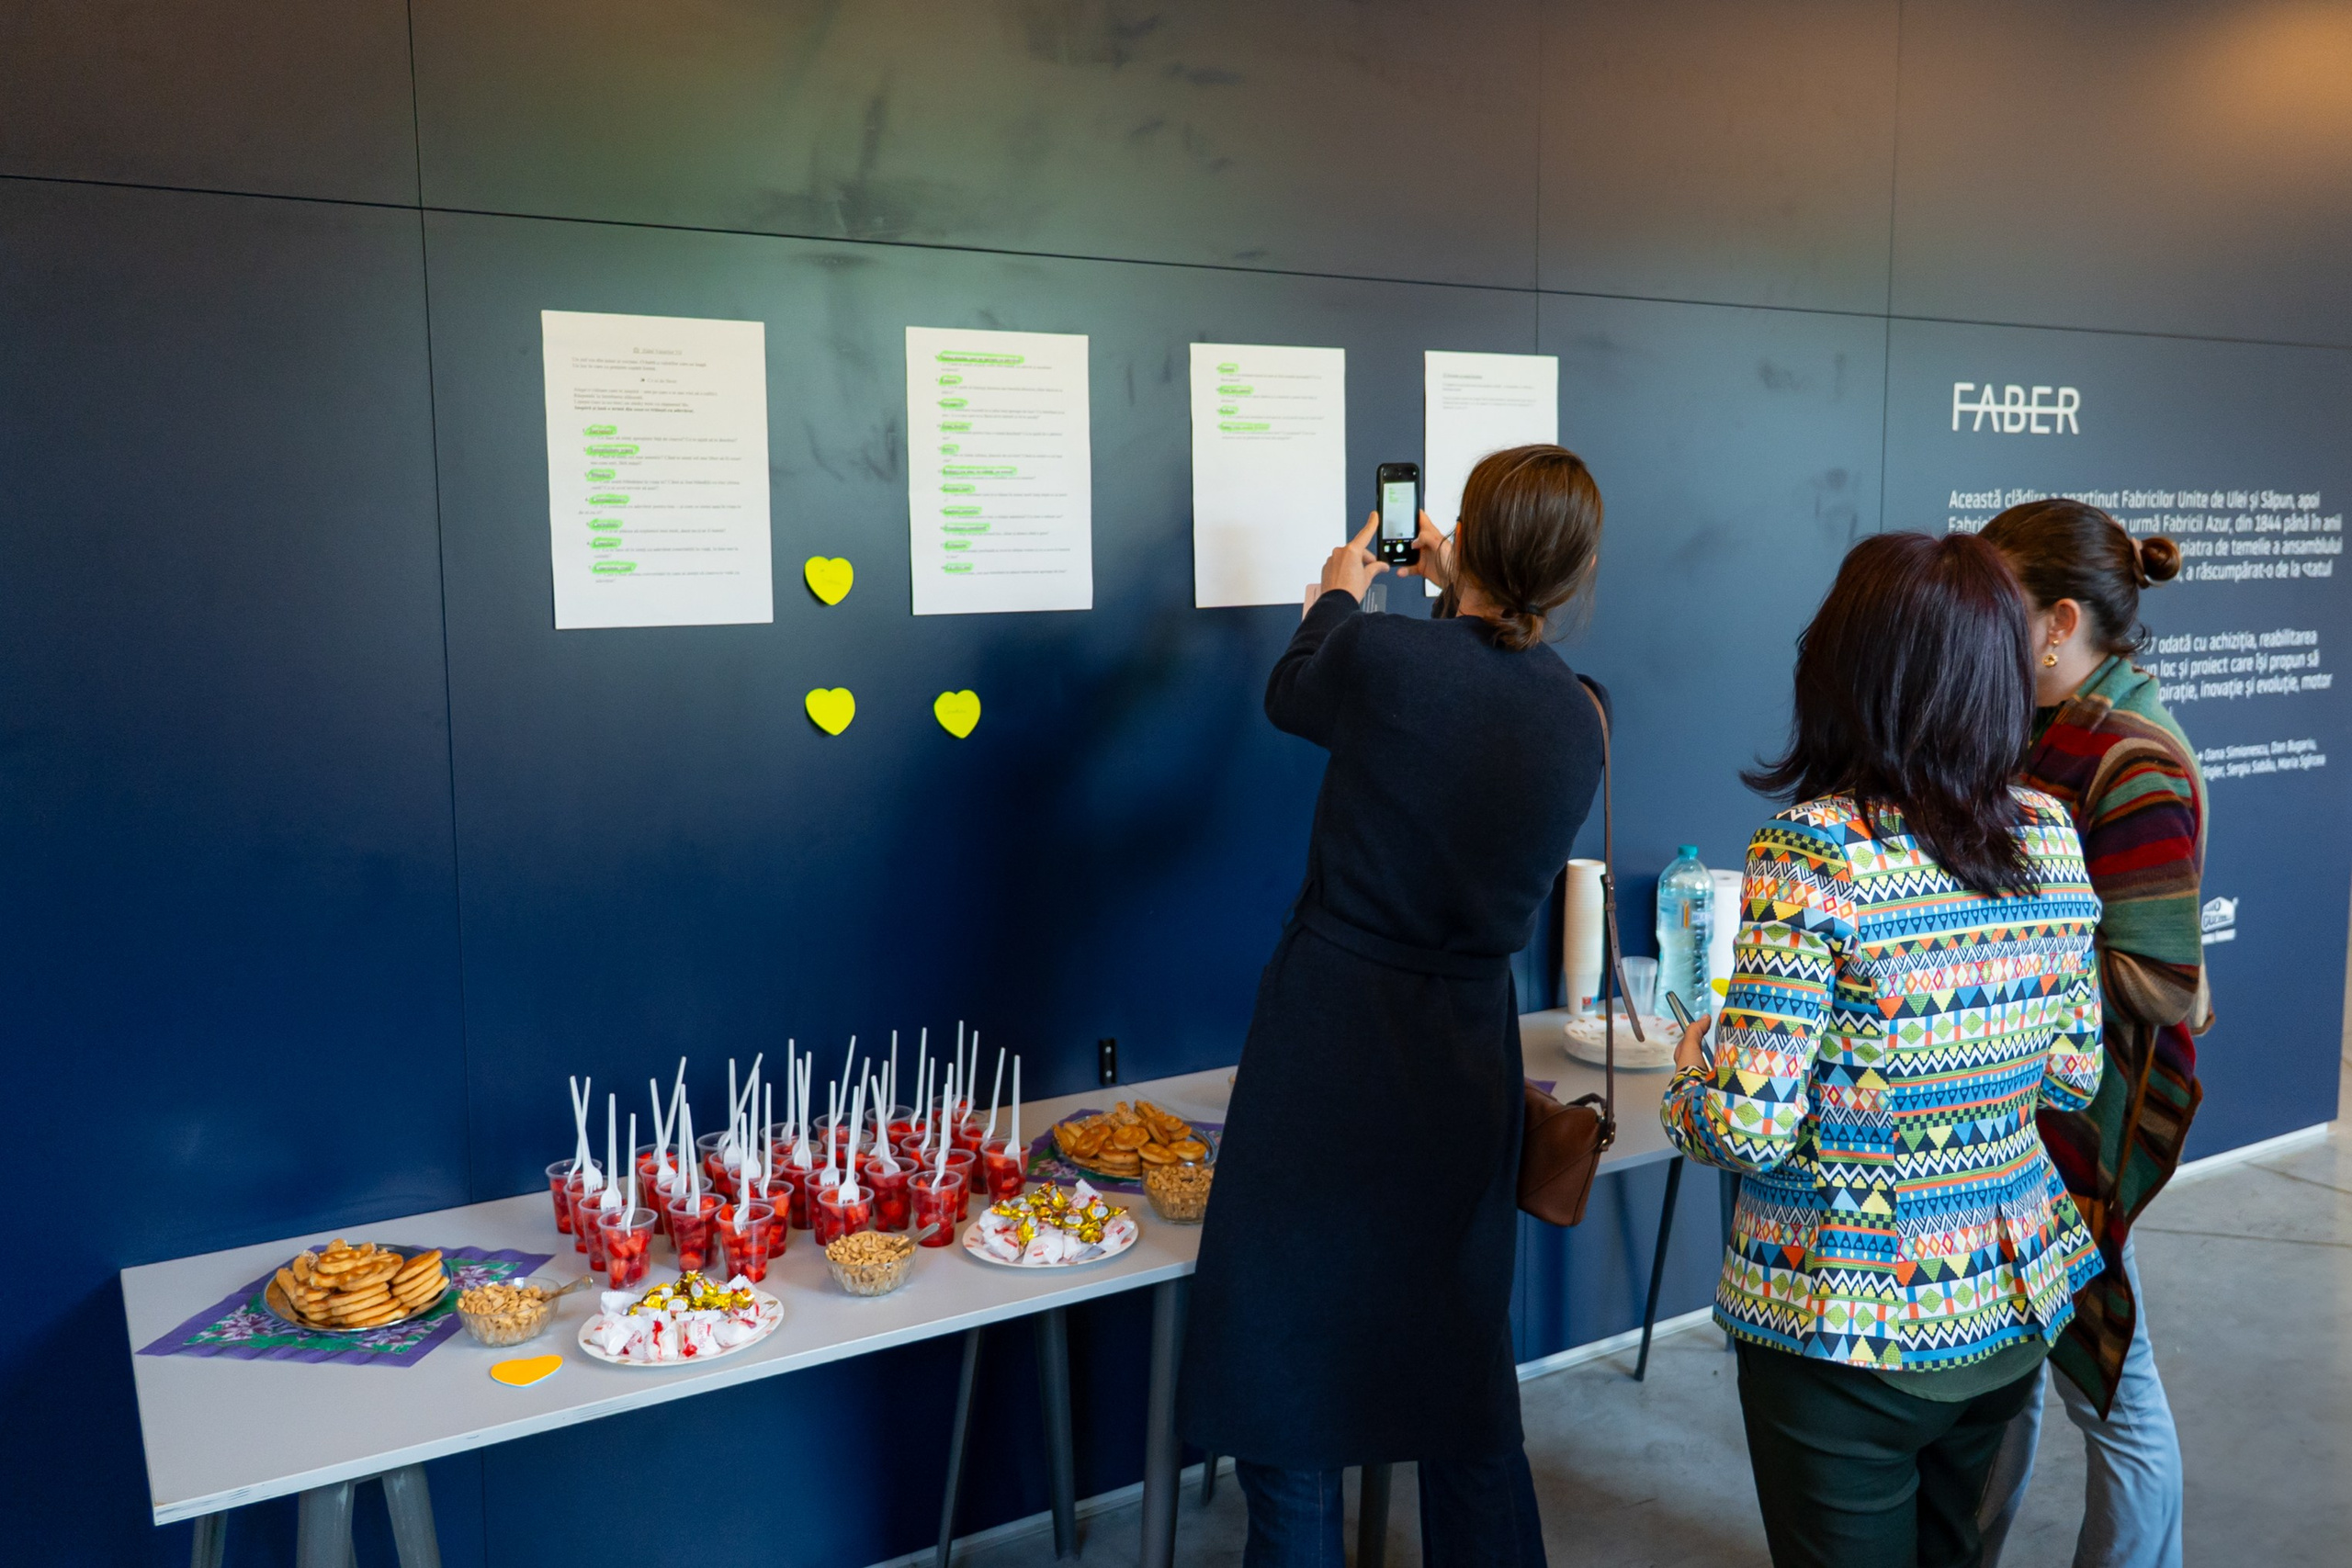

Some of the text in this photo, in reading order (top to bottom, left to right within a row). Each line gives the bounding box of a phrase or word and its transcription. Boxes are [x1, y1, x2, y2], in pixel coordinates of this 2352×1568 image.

[1951, 381, 2081, 435] FABER
[1949, 489, 2001, 509] Această
[2121, 489, 2175, 509] Fabricilor
[2177, 489, 2209, 509] Unite
[2211, 490, 2224, 509] de
[2226, 490, 2247, 509] Ulei
[2297, 491, 2320, 512] apoi
[2129, 514, 2159, 533] urmă
[2205, 515, 2233, 535] Azur,
[2234, 513, 2253, 533] din
[2255, 514, 2281, 533] 1844
[2214, 537, 2228, 557] de
[2232, 537, 2271, 556] temelie
[2272, 541, 2280, 556] a
[2186, 566, 2194, 581] a
[2275, 560, 2289, 579] de
[2290, 559, 2301, 578] la
[2158, 633, 2191, 654] odată
[2193, 637, 2208, 652] cu
[2259, 628, 2318, 648] reabilitarea
[2160, 659, 2177, 677] loc
[2190, 656, 2229, 678] proiect
[2231, 657, 2254, 672] care
[2269, 653, 2306, 672] propun
[2159, 682, 2199, 705] pirație,
[2301, 673, 2334, 690] motor
